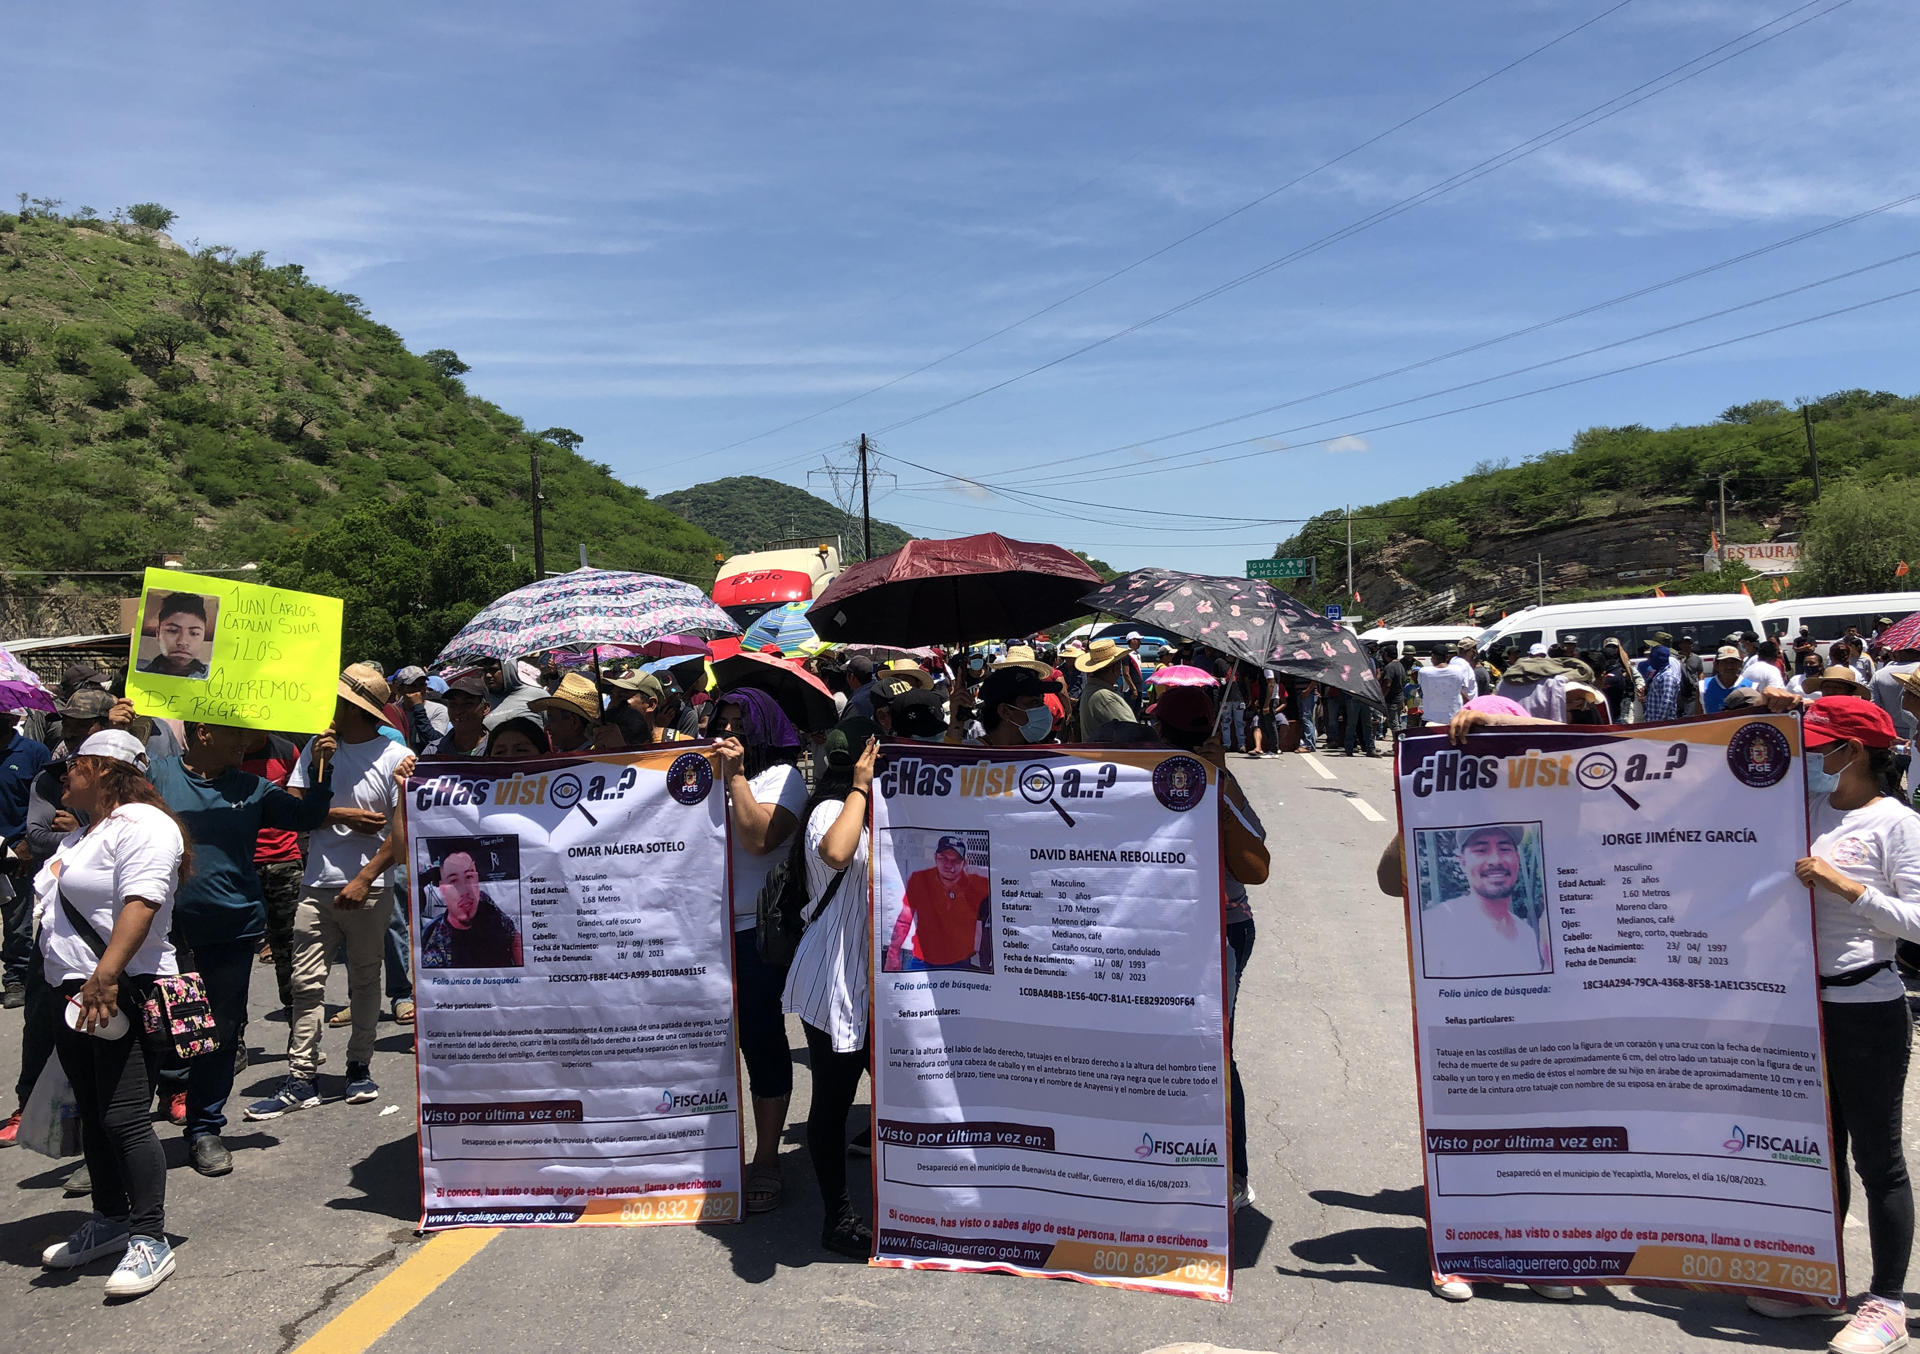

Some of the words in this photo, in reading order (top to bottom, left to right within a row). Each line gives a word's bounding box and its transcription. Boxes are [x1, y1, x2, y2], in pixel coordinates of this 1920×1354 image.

[1260, 568, 1303, 576] MEZCALA
[228, 586, 265, 616] JUAN
[270, 592, 316, 616] CARLOS
[208, 666, 311, 702] QUEREMOS
[141, 689, 181, 713] DE
[190, 696, 271, 720] REGRESO
[1748, 764, 1772, 772] FGE
[682, 784, 698, 792] FGE
[1602, 832, 1642, 845] JORGE
[1646, 830, 1701, 842] JIMÉNEZ
[1705, 829, 1757, 842] GARCÍA
[567, 846, 601, 857] OMAR
[604, 842, 644, 854] NÁJERA
[646, 841, 684, 852] SOTELO
[1030, 849, 1066, 859] DAVID
[1069, 849, 1116, 861] BAHENA
[1120, 851, 1185, 863] REBOLLEDO
[1613, 863, 1653, 871] Masculino
[1558, 879, 1577, 887] Edad
[1622, 876, 1631, 884] 26
[1641, 875, 1659, 883] años
[1559, 893, 1593, 901] Estatura:
[1623, 889, 1639, 897] 1.60
[1559, 906, 1575, 914] Tez:
[1562, 932, 1592, 941] Cabello:
[1617, 930, 1642, 938] Negro,
[1445, 1016, 1467, 1024] Señas
[1468, 1016, 1514, 1024] particulares:
[673, 1089, 728, 1108] FISCALÍA
[423, 1110, 456, 1122] Visto
[459, 1112, 481, 1123] por
[485, 1108, 525, 1121] última
[529, 1110, 552, 1120] vez
[555, 1110, 576, 1120] en:
[878, 1125, 912, 1142] Visto
[916, 1132, 943, 1146] por
[946, 1129, 992, 1143] última
[996, 1132, 1020, 1144] vez
[1024, 1134, 1047, 1147] en:
[1428, 1135, 1469, 1150] Visto
[1473, 1136, 1500, 1152] por
[1504, 1132, 1553, 1148] última
[1559, 1135, 1588, 1148] vez
[1592, 1134, 1619, 1148] en:
[1746, 1134, 1820, 1156] FISCALÍA
[1154, 1138, 1217, 1156] FISCALÍA
[1553, 1169, 1561, 1177] el
[1612, 1170, 1653, 1178] Yecapixtla,
[1655, 1171, 1690, 1179] Morelos,
[1701, 1172, 1714, 1181] día
[1716, 1174, 1765, 1185] 16/08/2023.
[436, 1187, 445, 1198] Si
[446, 1188, 482, 1197] conoces,
[485, 1186, 499, 1196] has
[502, 1186, 521, 1195] visto
[531, 1186, 554, 1195] sabes
[557, 1185, 573, 1197] algo
[575, 1185, 585, 1195] de
[587, 1184, 604, 1196] esta
[606, 1184, 642, 1197] persona,
[644, 1182, 666, 1192] llama
[676, 1179, 722, 1190] escríbenos
[428, 1210, 574, 1223] www.fiscaliaguerrero.gob.mx
[621, 1202, 652, 1221] 800
[656, 1199, 688, 1219] 832
[692, 1198, 734, 1218] 7692
[889, 1208, 897, 1218] Si
[899, 1214, 937, 1224] conoces,
[940, 1217, 956, 1227] has
[959, 1217, 982, 1227] visto
[984, 1219, 990, 1227] o
[992, 1219, 1019, 1229] sabes
[1021, 1220, 1041, 1233] algo
[1043, 1222, 1054, 1232] de
[1056, 1226, 1075, 1235] esta
[1077, 1229, 1116, 1240] persona,
[1119, 1231, 1145, 1241] llama
[1147, 1234, 1154, 1242] o
[1156, 1235, 1208, 1247] escríbenos
[880, 1235, 1041, 1261] www.fiscaliaguerrero.gob.mx
[1445, 1228, 1455, 1240] Si
[1458, 1230, 1501, 1239] conoces,
[1505, 1228, 1522, 1238] has
[1525, 1228, 1550, 1238] visto
[1552, 1230, 1559, 1238] o
[1562, 1228, 1592, 1238] sabes
[1595, 1229, 1617, 1241] algo
[1620, 1228, 1633, 1239] de
[1636, 1231, 1658, 1240] esta
[1660, 1232, 1707, 1243] persona,
[1711, 1233, 1740, 1246] llama
[1743, 1238, 1751, 1247] o
[1754, 1240, 1815, 1254] escríbenos
[1093, 1250, 1128, 1272] 800
[1134, 1253, 1168, 1275] 832
[1175, 1256, 1221, 1282] 7692
[1441, 1254, 1621, 1274] www.fiscaliaguerrero.gob.mx
[1682, 1254, 1722, 1278] 800
[1729, 1258, 1770, 1282] 832
[1778, 1263, 1832, 1291] 7692
